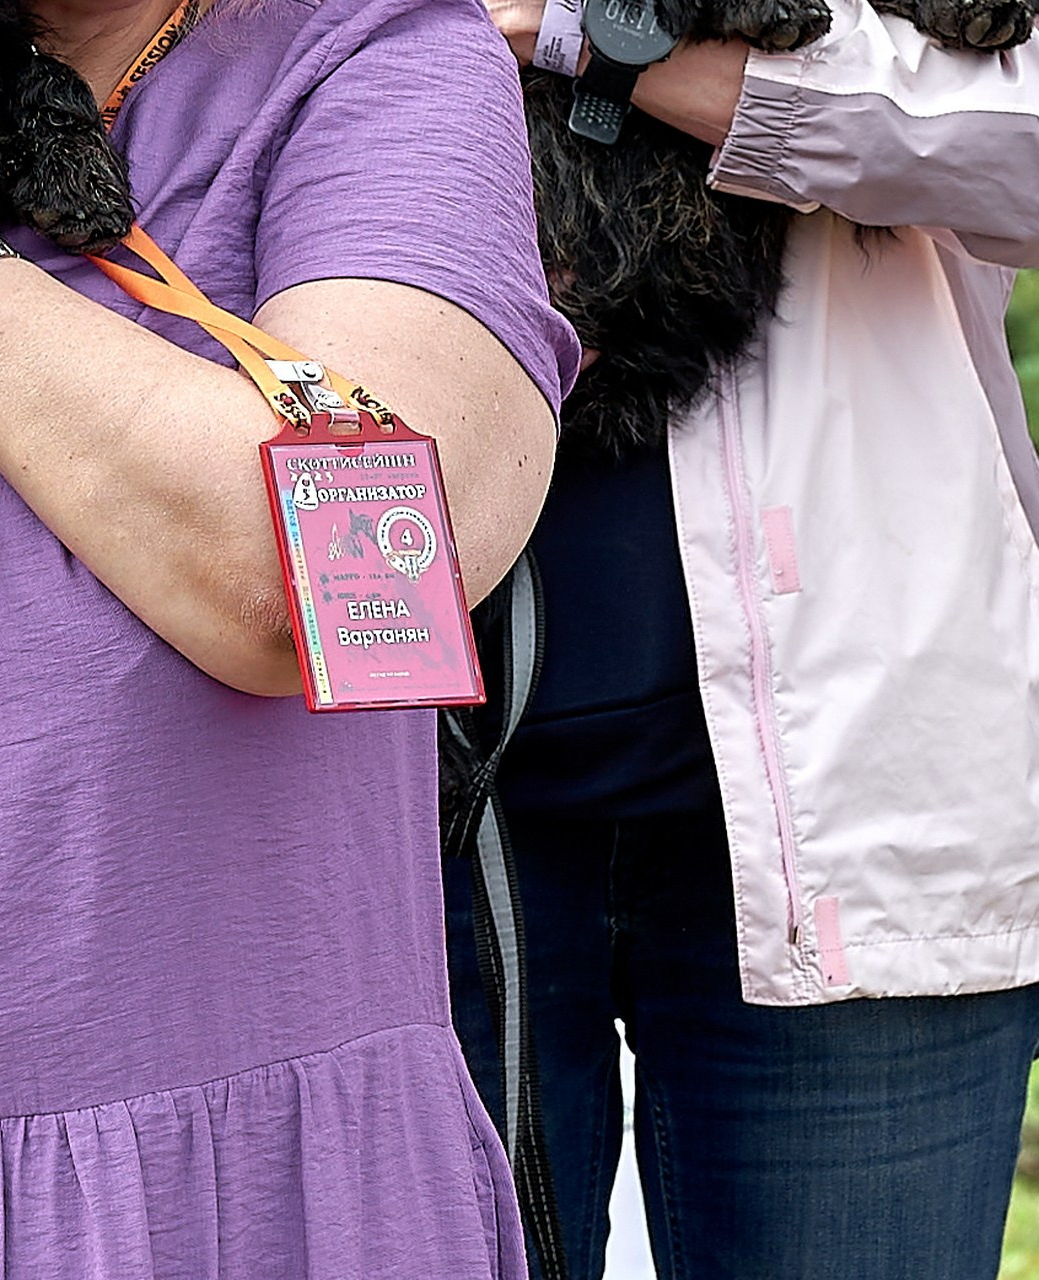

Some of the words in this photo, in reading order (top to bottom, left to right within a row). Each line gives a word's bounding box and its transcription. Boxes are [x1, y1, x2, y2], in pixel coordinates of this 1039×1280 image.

[286, 453, 416, 471] СКОТТИСЕЙШН
[316, 483, 427, 503] ОРГАНИЗАТОР
[346, 598, 412, 621] ЕЛЕНА
[336, 625, 431, 651] Вартанян
